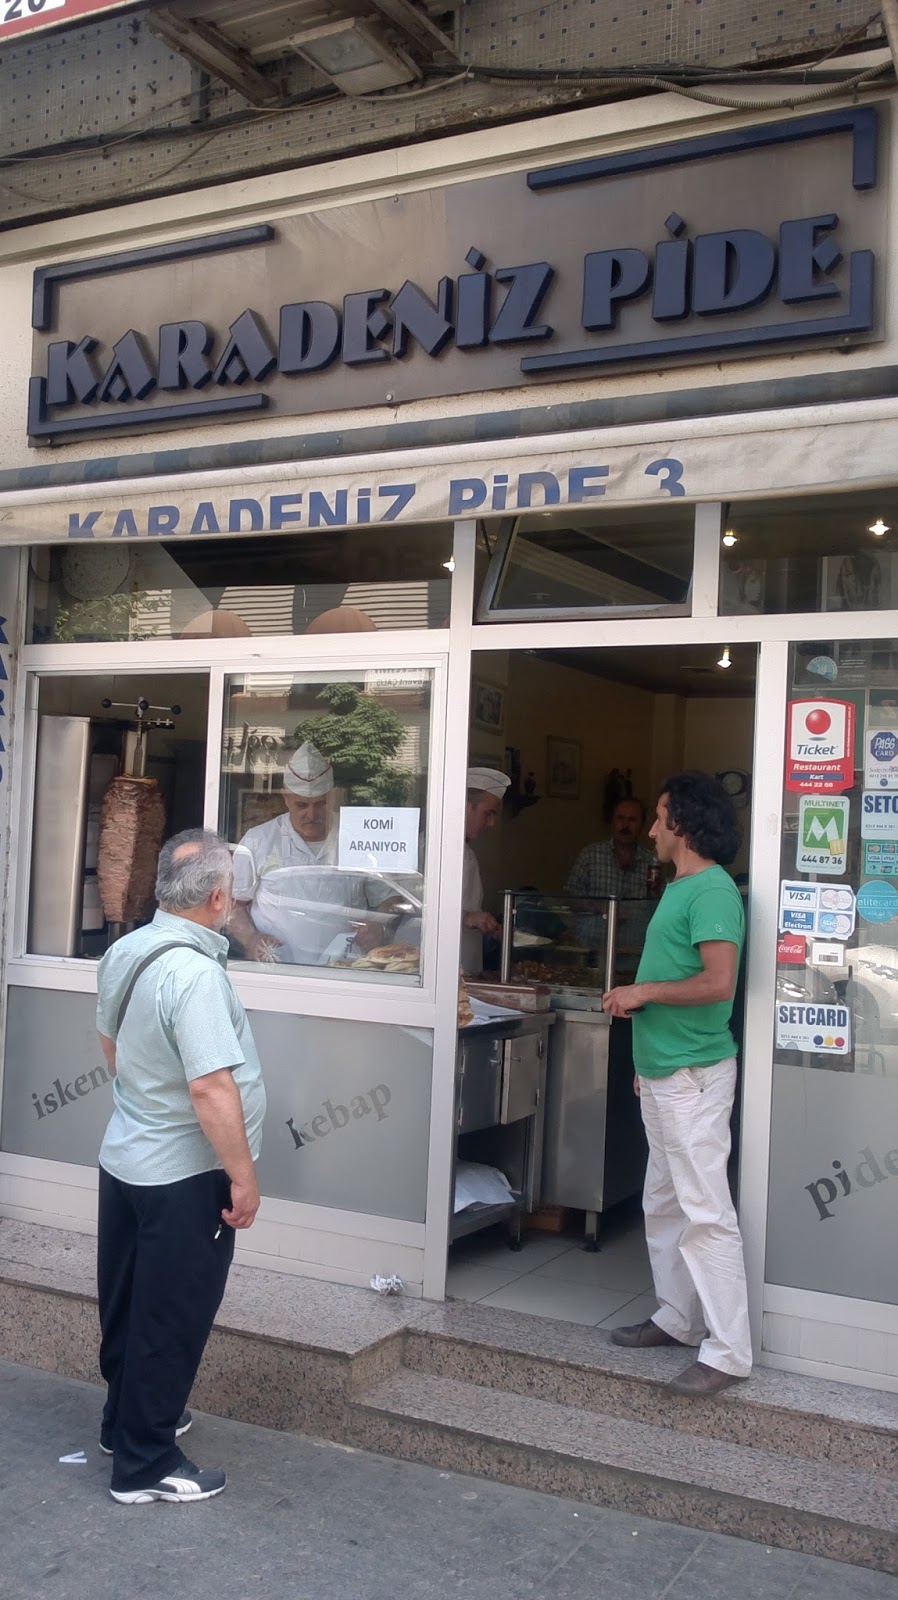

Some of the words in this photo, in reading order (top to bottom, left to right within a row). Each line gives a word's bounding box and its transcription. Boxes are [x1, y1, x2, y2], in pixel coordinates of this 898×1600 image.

[46, 246, 555, 407] KARADENİZ
[581, 212, 843, 332] PİDE
[644, 458, 686, 497] 3
[796, 744, 836, 756] Ticket
[793, 763, 841, 771] Restaurant
[804, 800, 845, 808] MULTINET
[363, 817, 394, 830] KOMİ
[349, 841, 407, 853] ARANIYOR
[801, 855, 817, 863] 444
[819, 856, 830, 864] 87
[832, 857, 842, 865] 36
[789, 892, 811, 901] VISA
[790, 911, 807, 919] VISA
[784, 921, 812, 930] Electron
[779, 1005, 847, 1028] SETCARD
[31, 1066, 113, 1120] isken
[284, 1082, 392, 1150] kebap
[804, 1144, 898, 1221] pide
